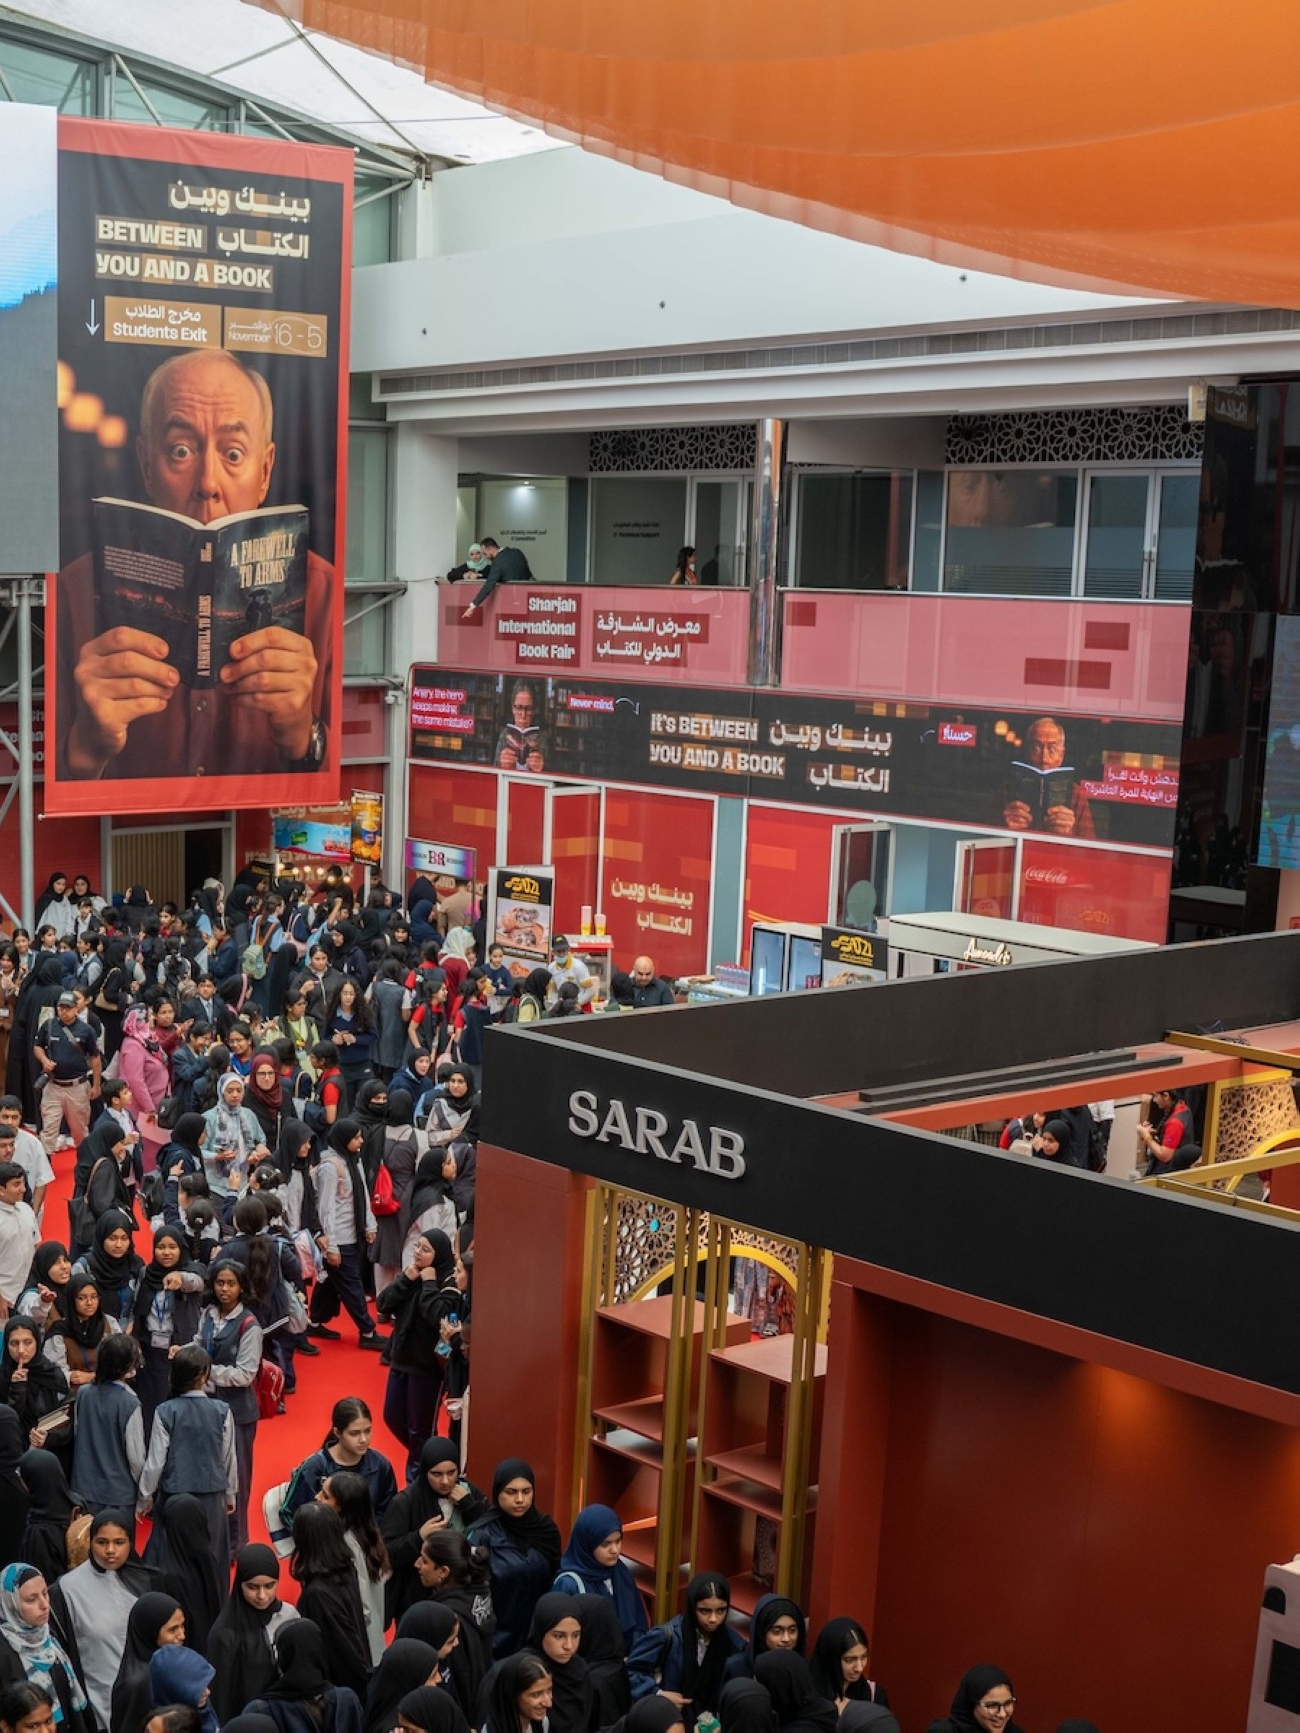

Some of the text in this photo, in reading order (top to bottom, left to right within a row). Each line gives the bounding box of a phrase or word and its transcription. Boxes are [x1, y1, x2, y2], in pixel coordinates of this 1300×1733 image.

[171, 180, 311, 223] بينك وبين
[98, 219, 202, 248] BETWEEN
[217, 228, 309, 259] الكتاب
[96, 254, 271, 289] YOU AND A BOOK
[125, 305, 201, 324] مخرج الطلاب
[112, 323, 207, 342] Students Exit
[229, 331, 271, 343] November
[274, 322, 292, 346] 16
[308, 326, 322, 348] 5
[230, 543, 239, 567] A
[241, 533, 296, 564] FAREWELL
[239, 559, 285, 589] TO ARMS
[528, 597, 576, 614] Sharjah
[497, 619, 577, 637] International
[597, 613, 701, 638] معرض الشارقة
[519, 643, 576, 660] Book Fair
[597, 640, 681, 665] الدولي للكتاب
[679, 716, 758, 742] BETWEEN
[769, 719, 893, 757] بينك وبين
[650, 743, 785, 775] YOU AND A BOOK
[809, 764, 890, 793] الكتاب
[611, 877, 694, 910] بينك وبين
[637, 912, 692, 936] الكتاب
[568, 1090, 747, 1180] SARAB
